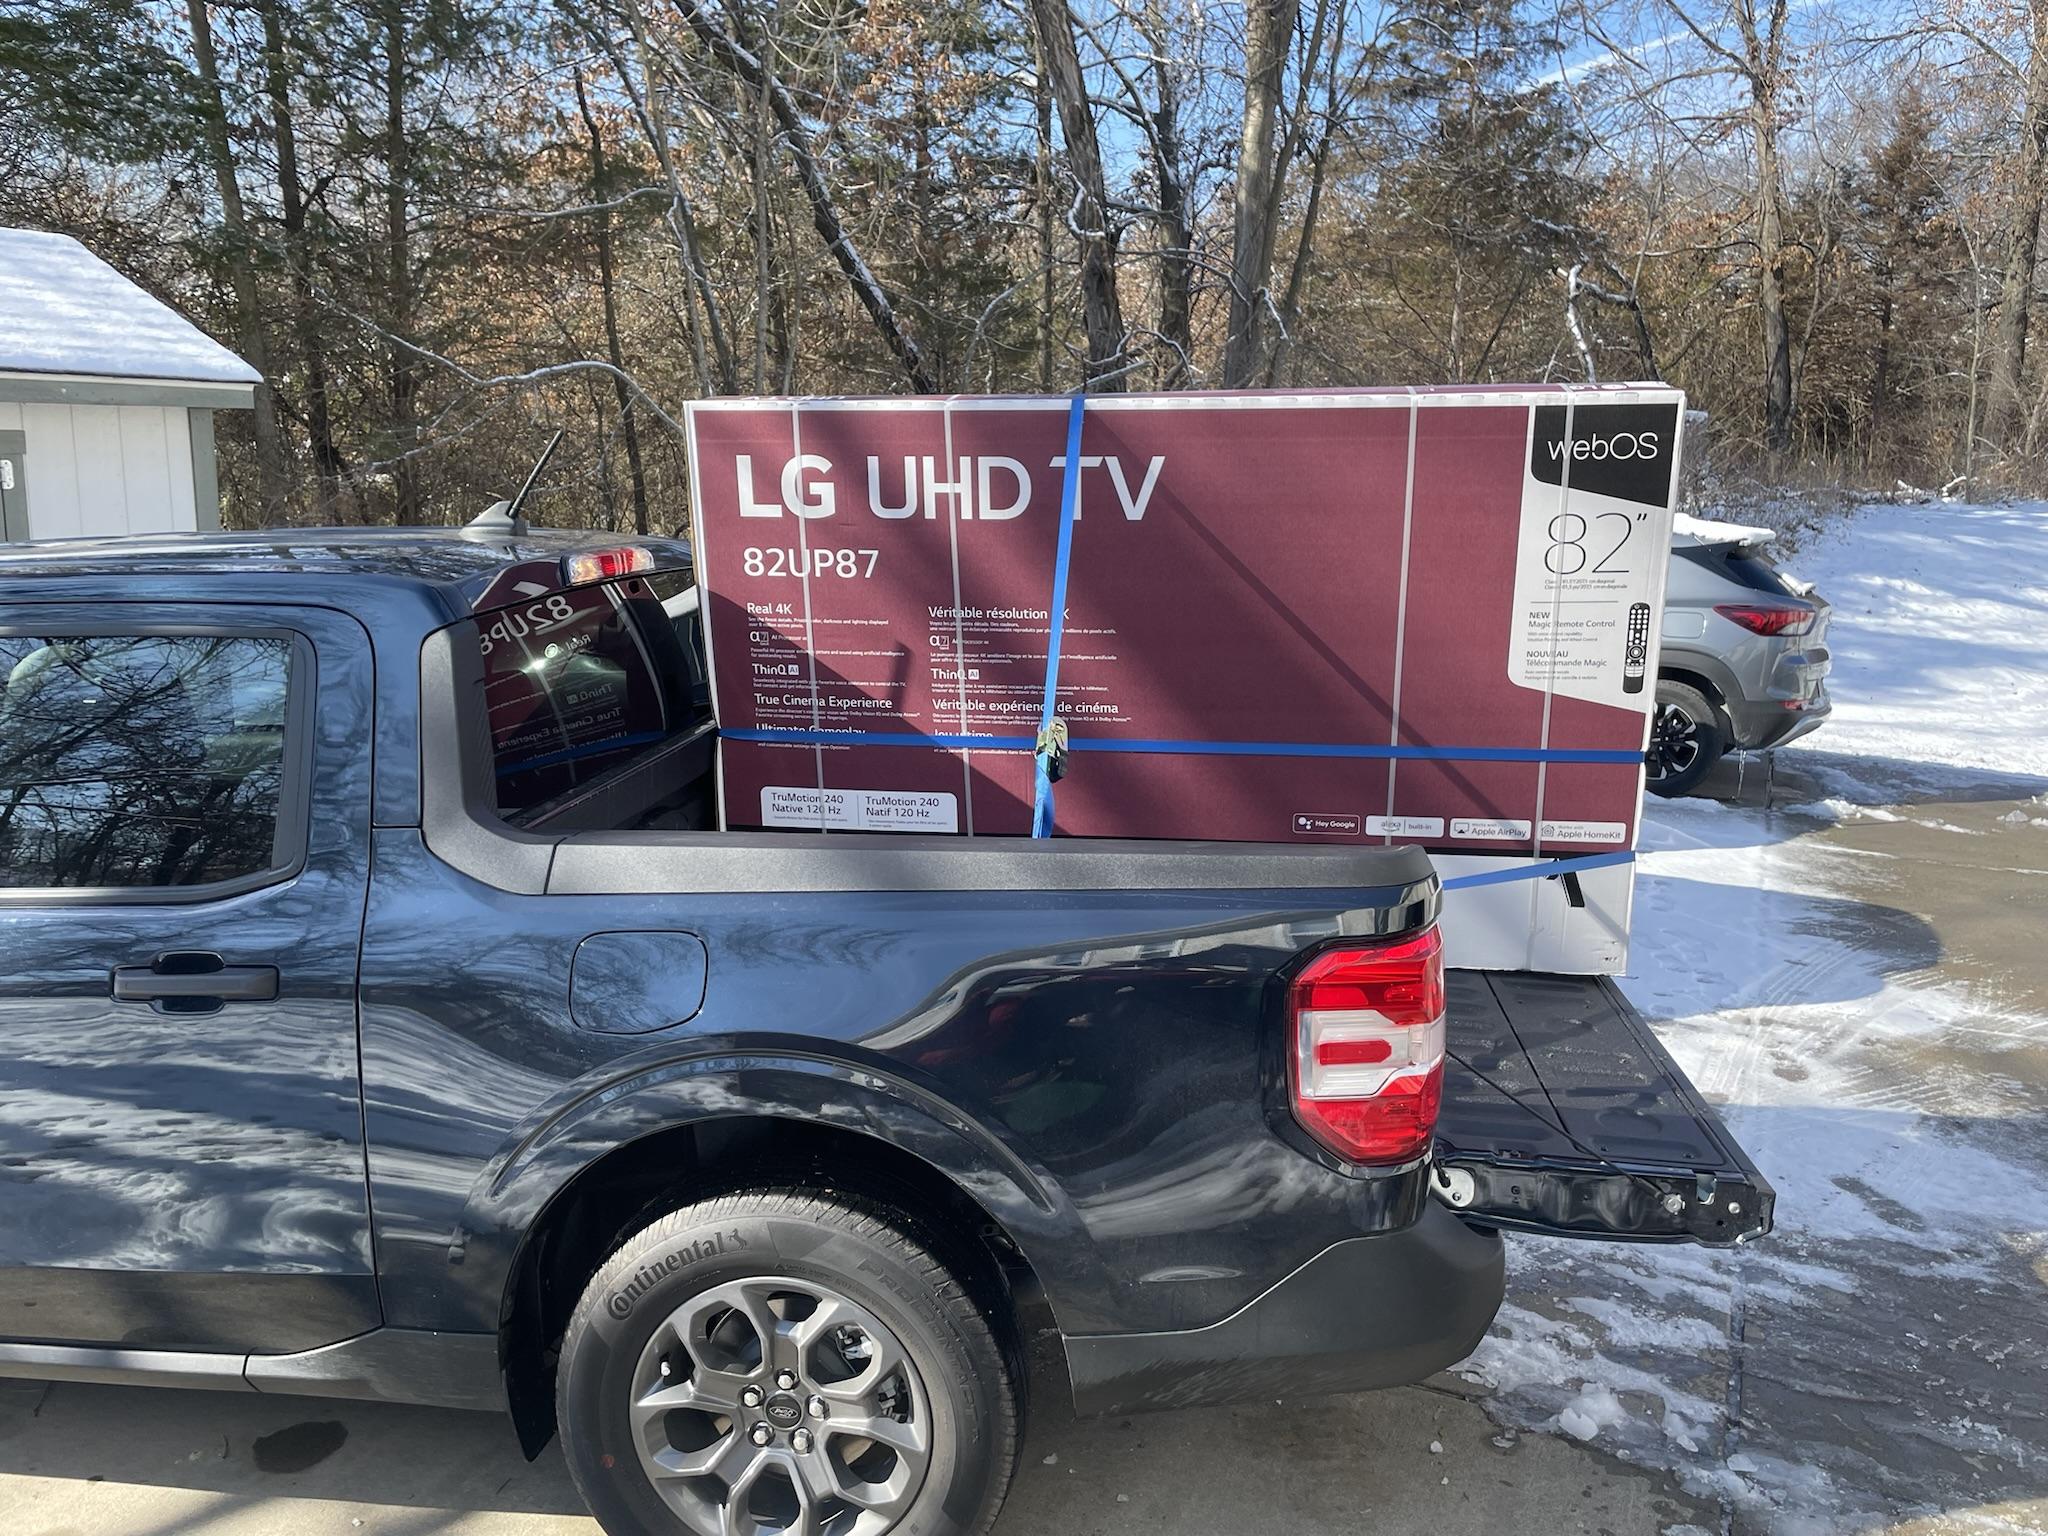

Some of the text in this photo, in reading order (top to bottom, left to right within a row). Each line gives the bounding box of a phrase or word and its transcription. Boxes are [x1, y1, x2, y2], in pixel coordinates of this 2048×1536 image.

[1547, 432, 1658, 461] webOS
[735, 454, 1165, 521] LG UHD TV
[743, 547, 879, 579] 82UP87
[747, 603, 792, 615] Real 4K
[929, 606, 982, 619] Véritable
[987, 608, 1048, 620] résolution
[1529, 621, 1551, 629] Magic
[752, 664, 798, 675] ThinQ AI
[1584, 660, 1607, 668] Magic
[931, 668, 978, 680] ThinQ AI
[754, 693, 892, 710] True Cinema Experience
[932, 699, 1119, 714] Véritable expérienc de cinéma
[772, 793, 844, 804] TruMotion 240
[866, 796, 939, 807] TruMotion 240
[772, 804, 841, 815] Native 120 Hz
[866, 807, 930, 818] Natif 120 Hz
[1316, 820, 1356, 829] Hey Google
[1472, 828, 1527, 838] Apple AirPlay
[1558, 831, 1621, 840] Apple HomeKit
[607, 1231, 726, 1320] Continental
